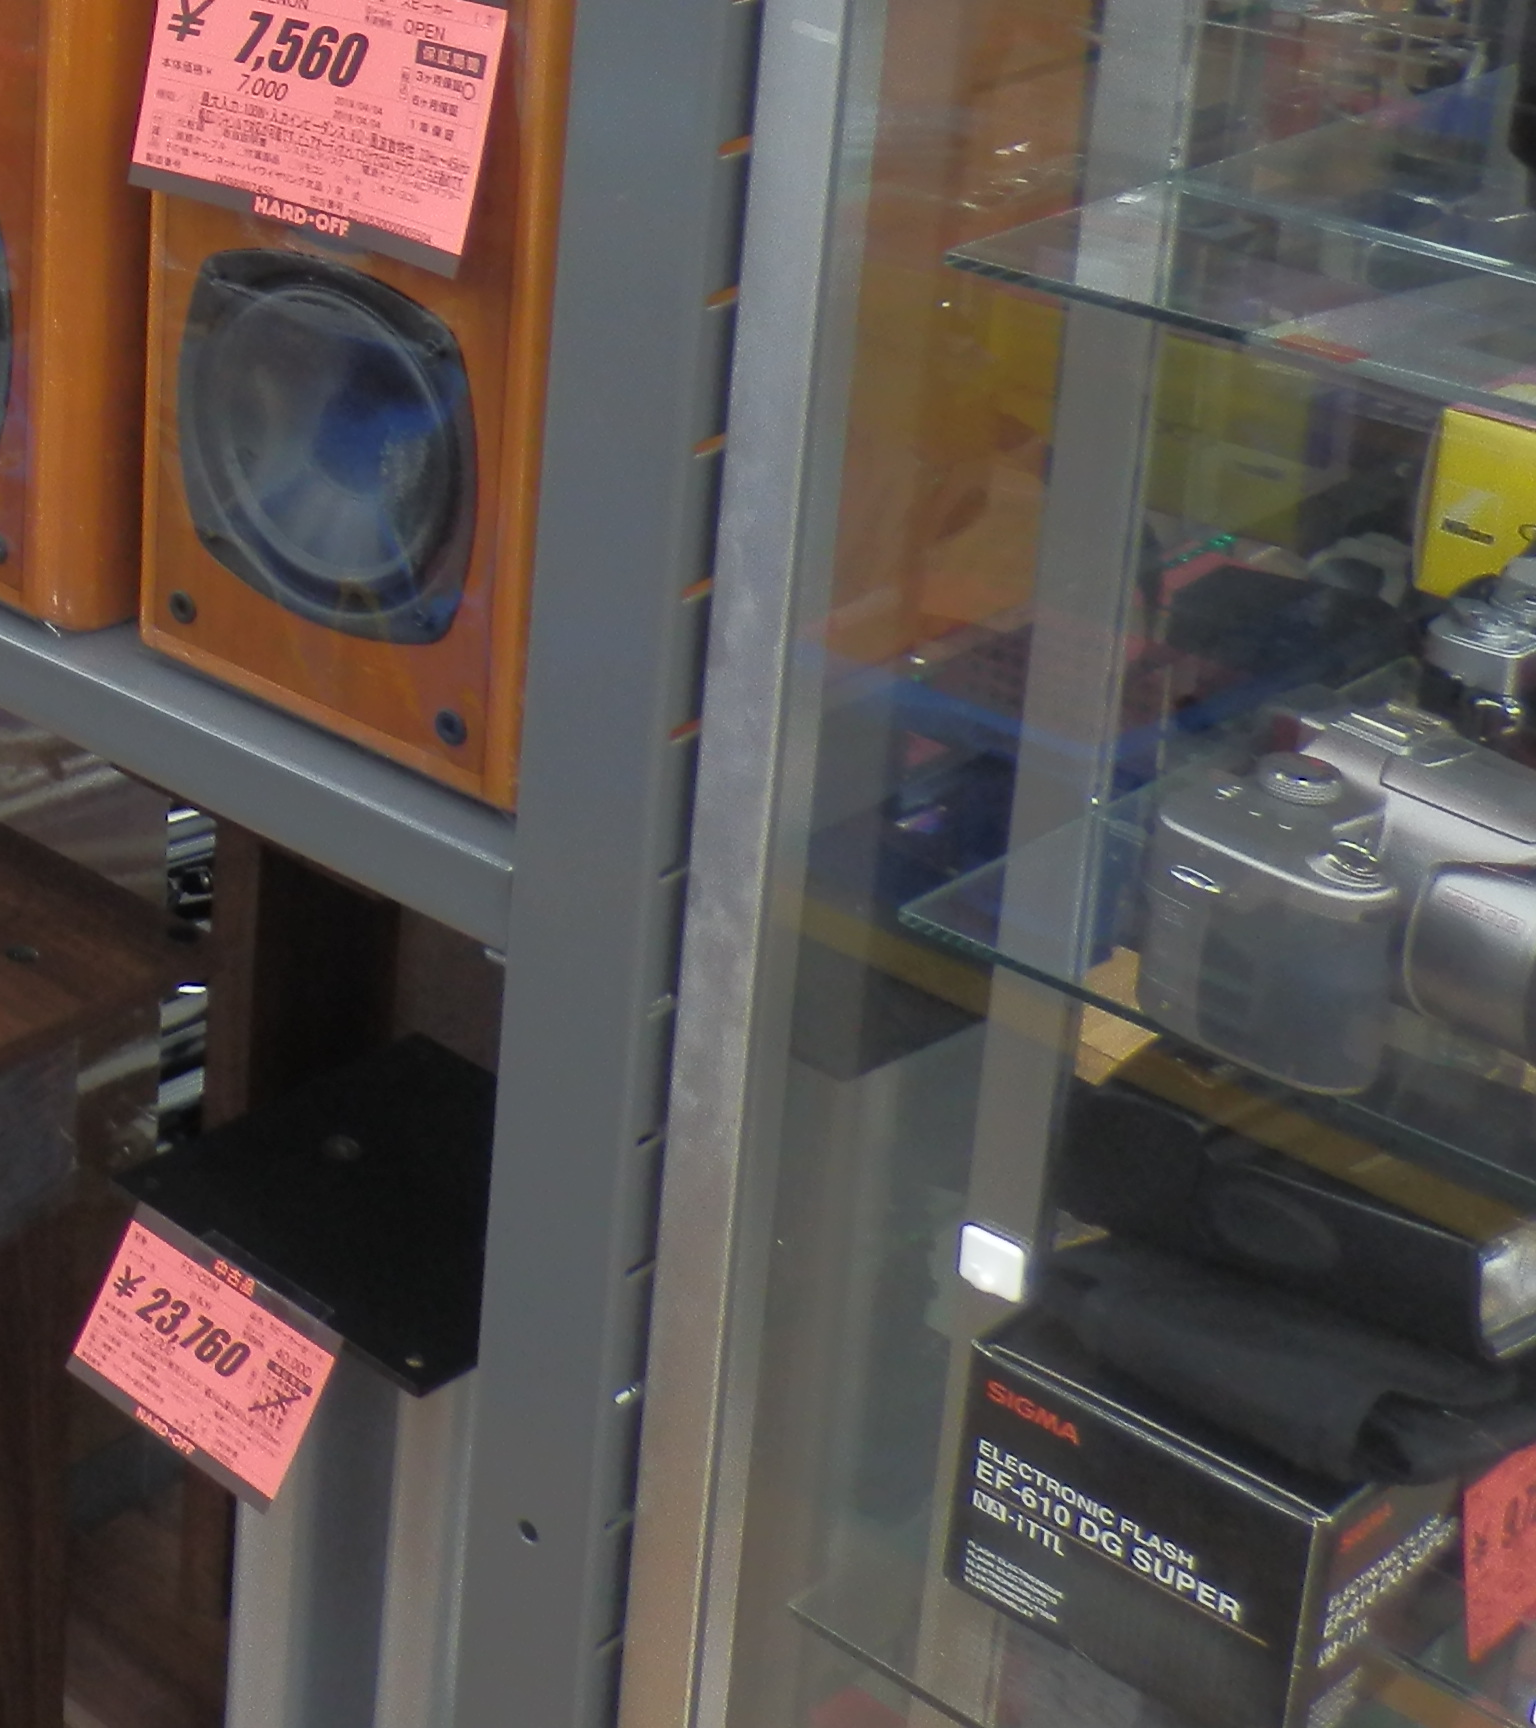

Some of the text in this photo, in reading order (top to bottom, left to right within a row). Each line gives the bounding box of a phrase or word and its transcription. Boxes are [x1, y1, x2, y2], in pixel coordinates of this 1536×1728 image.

[233, 10, 370, 88] 7,560
[404, 19, 446, 41] OPEN
[210, 1257, 258, 1295] 中古品
[112, 1264, 148, 1301] ¥
[136, 1287, 252, 1378] 23,760
[986, 1379, 1080, 1446] SIGMA
[976, 1457, 1071, 1528] EF-610
[1079, 1516, 1124, 1558] DG
[1132, 1546, 1241, 1623] SUPER
[979, 1437, 1197, 1571] ELECTRONIC FLASH
